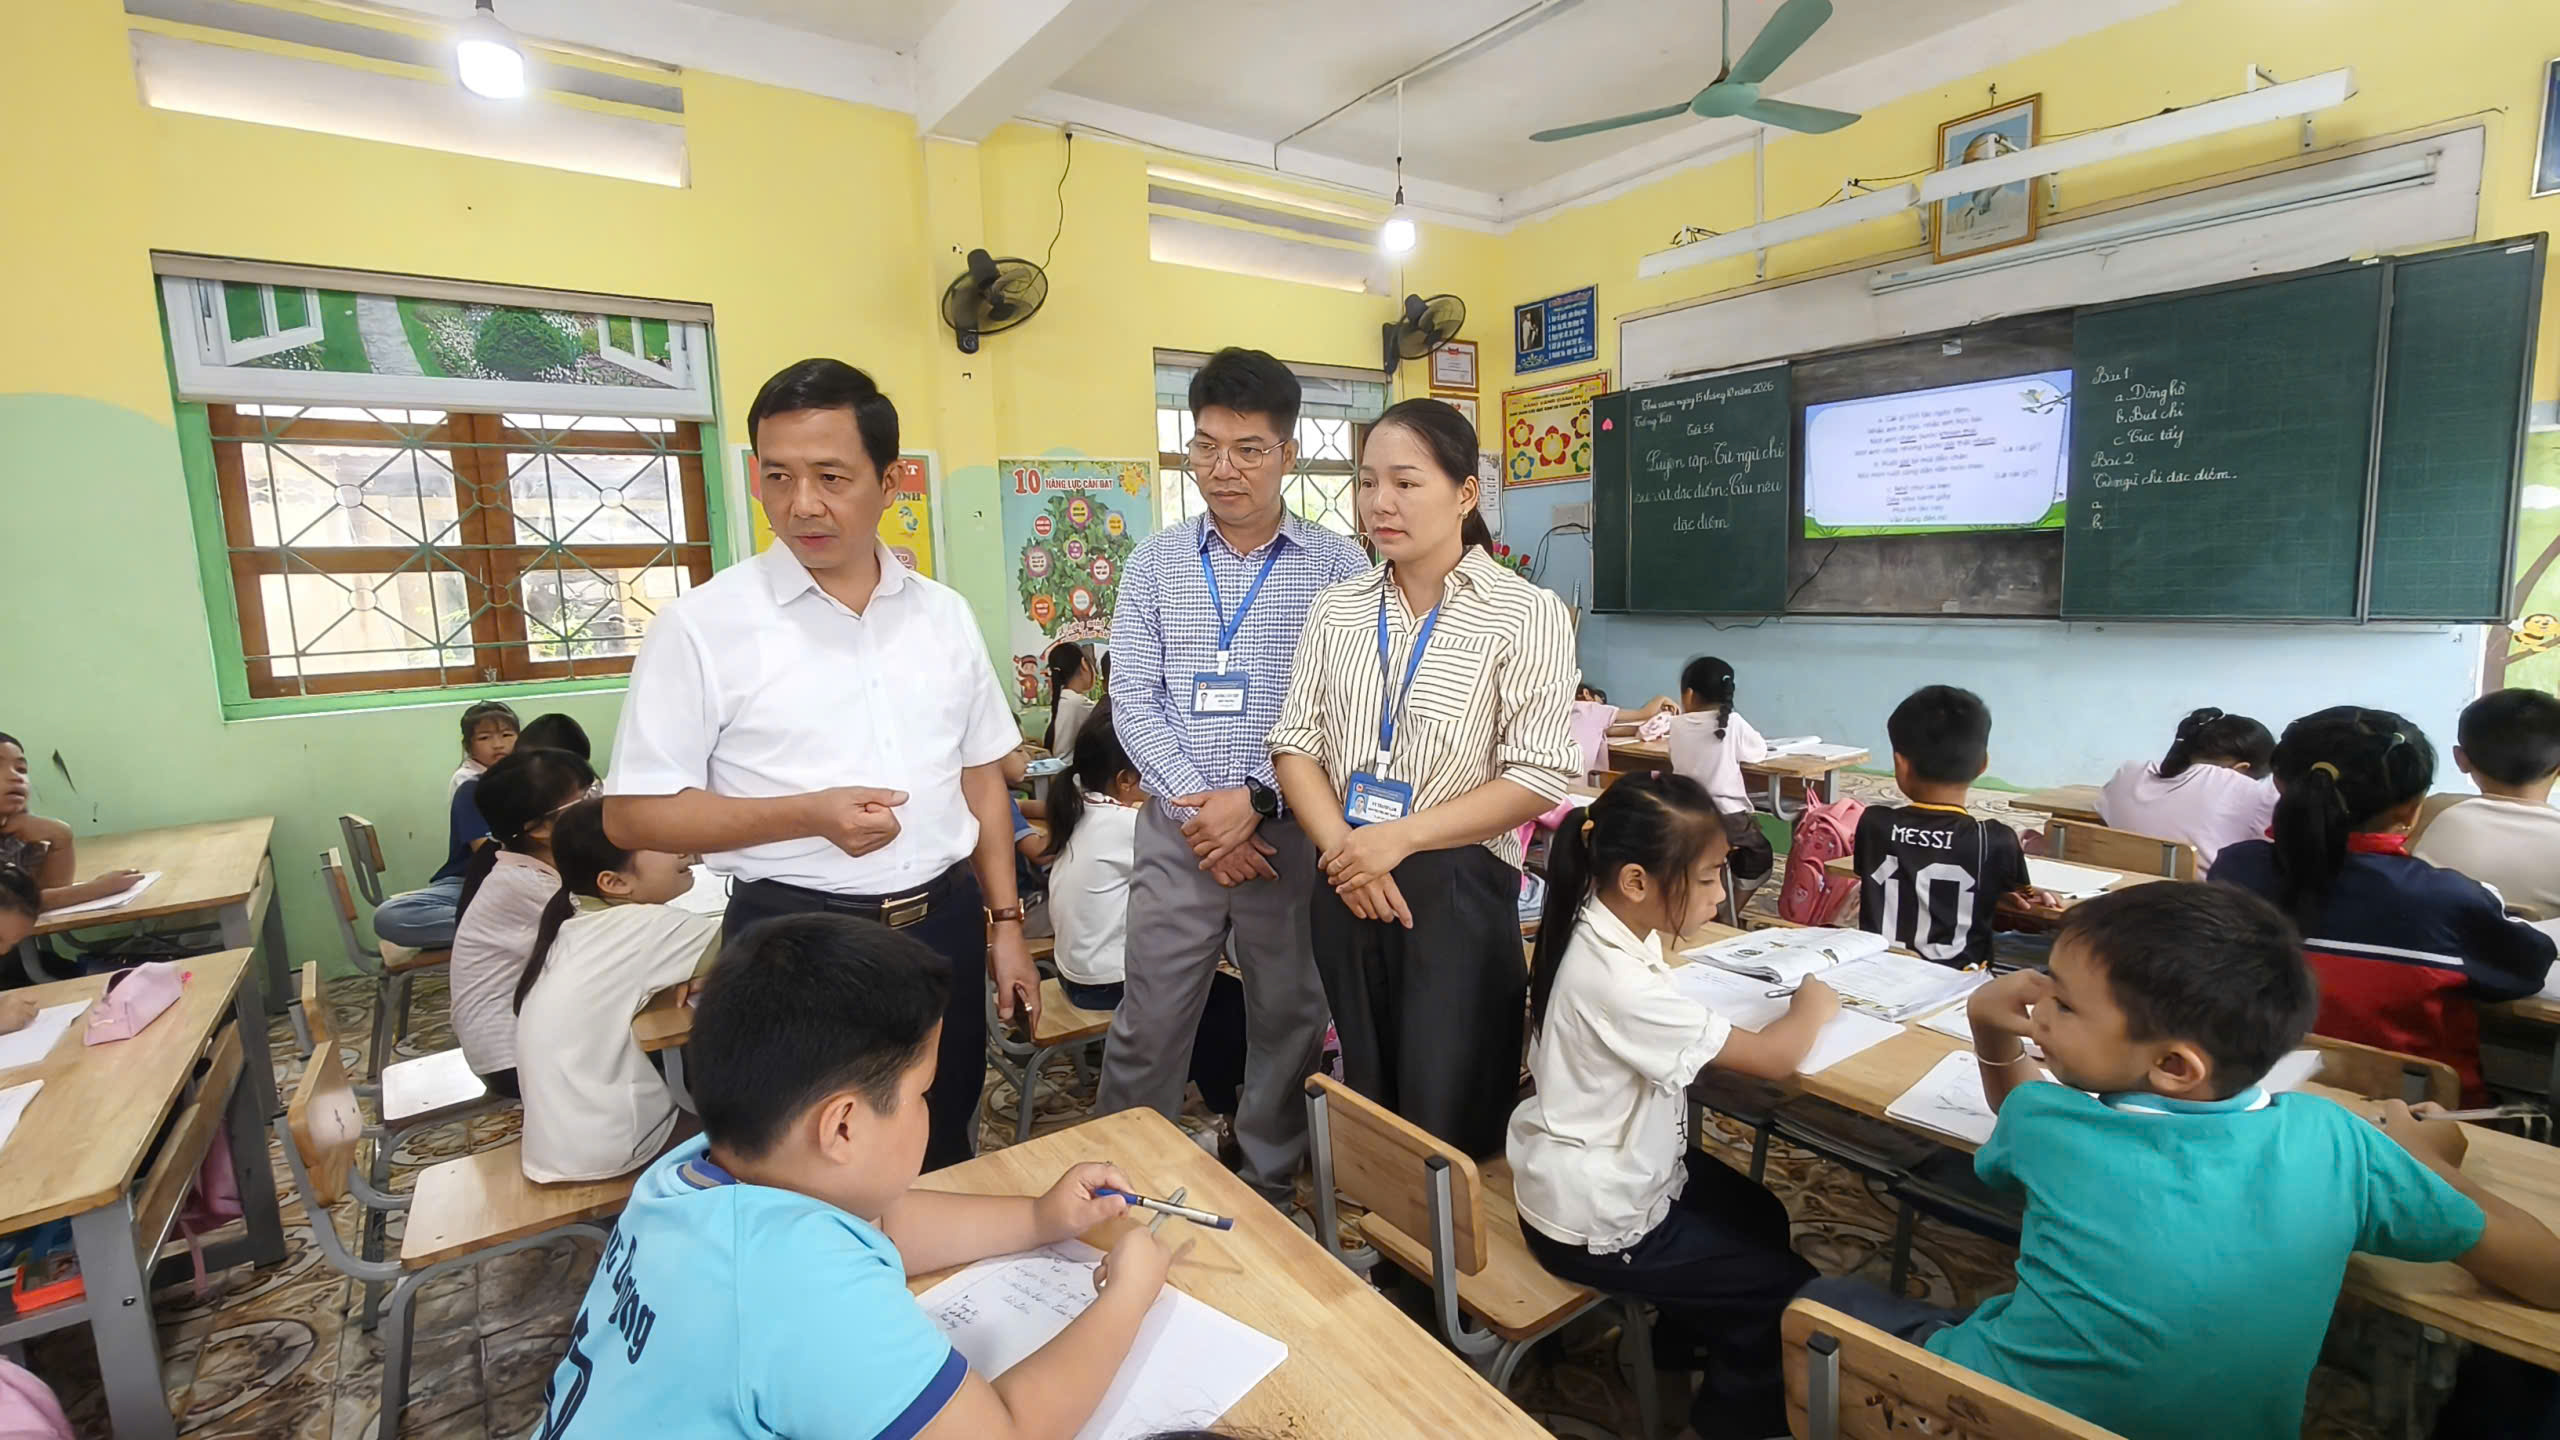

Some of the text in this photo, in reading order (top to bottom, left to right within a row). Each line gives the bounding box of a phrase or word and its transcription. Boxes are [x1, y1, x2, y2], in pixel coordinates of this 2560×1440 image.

[2123, 452, 2135, 465] 2
[1014, 470, 1041, 494] 10
[1891, 824, 1954, 850] MESSI
[1871, 854, 1976, 960] 10
